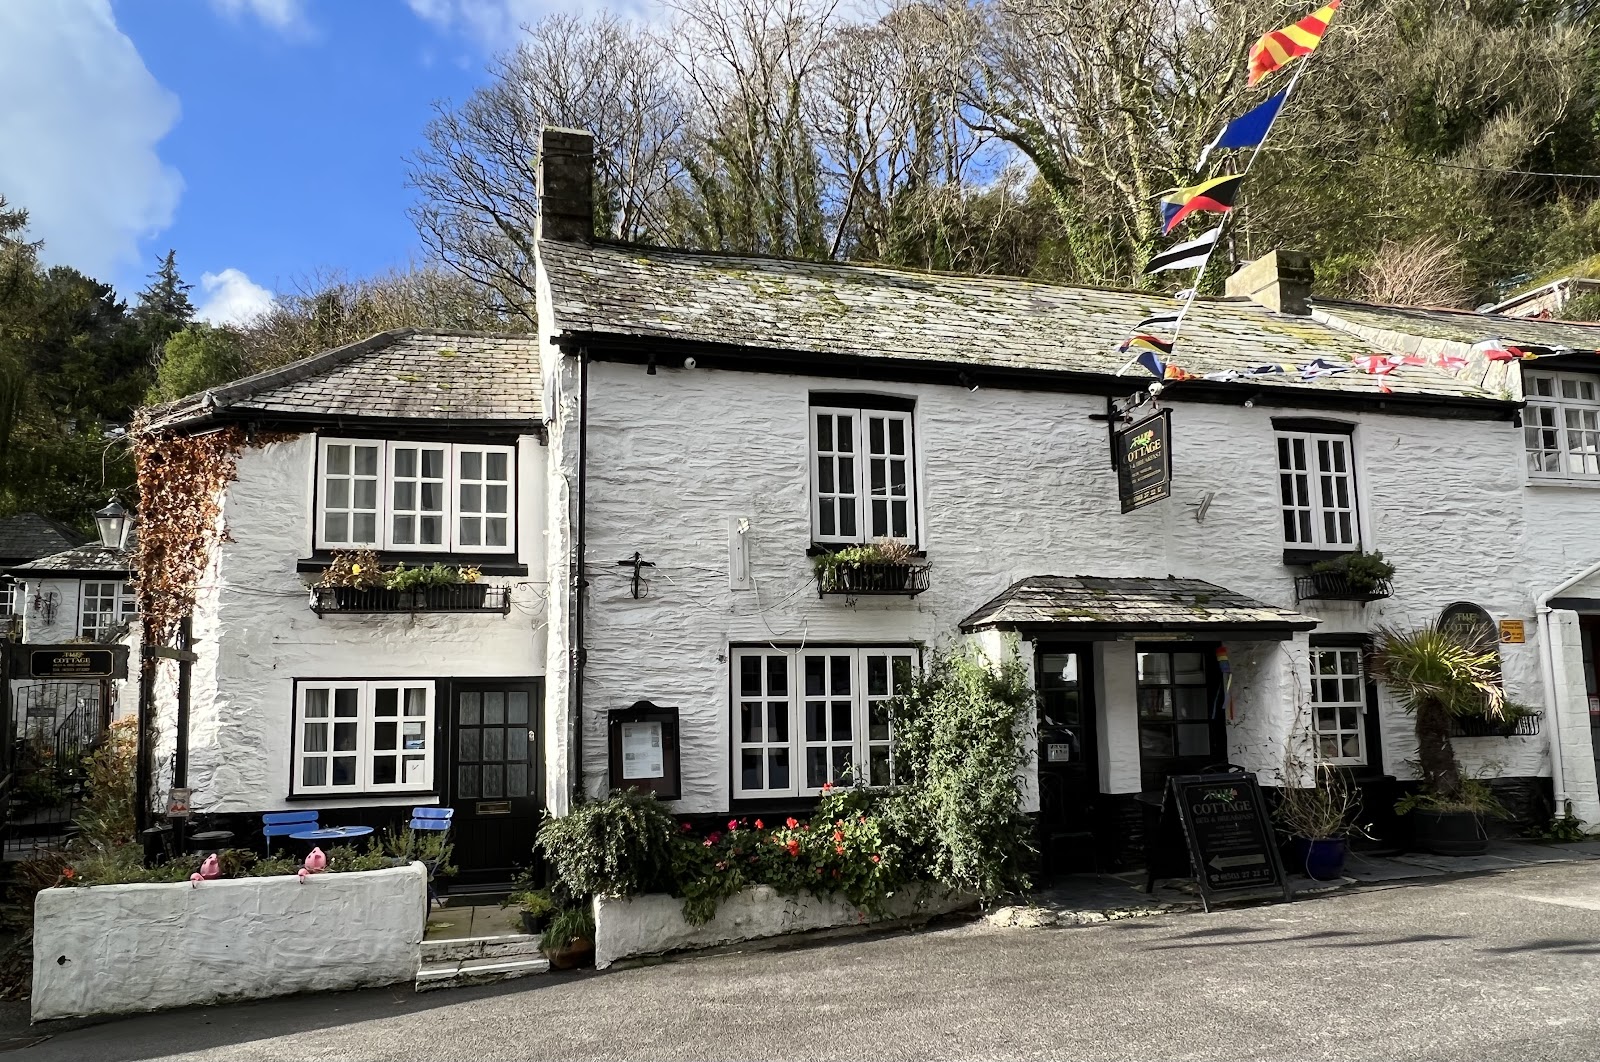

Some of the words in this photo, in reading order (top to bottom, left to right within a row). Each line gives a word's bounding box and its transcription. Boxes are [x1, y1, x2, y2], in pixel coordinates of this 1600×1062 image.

[1123, 439, 1162, 464] COTTAGE
[1455, 612, 1477, 622] THE
[1193, 800, 1252, 815] COTTAGE
